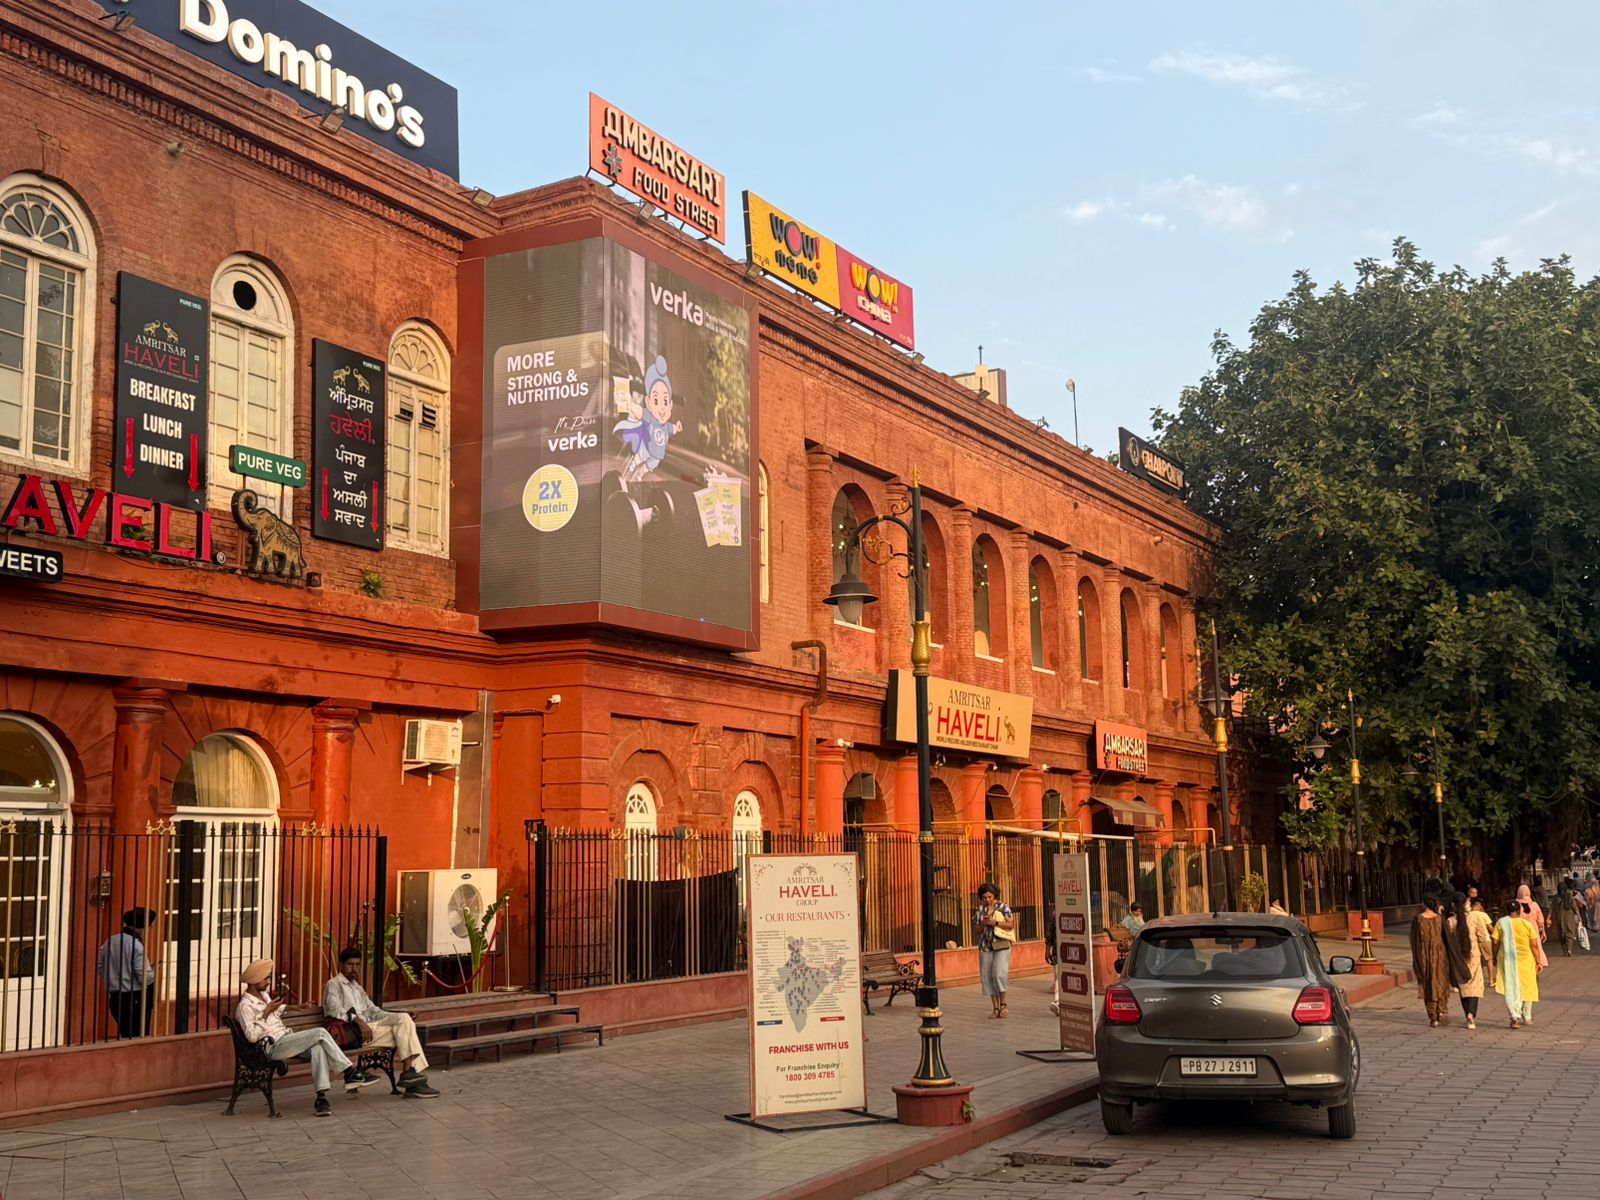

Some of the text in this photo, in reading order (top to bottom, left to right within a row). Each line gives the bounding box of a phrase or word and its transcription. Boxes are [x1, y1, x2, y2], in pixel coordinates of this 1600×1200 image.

[179, 0, 426, 148] Domino's
[602, 106, 722, 208] AMBARSARI
[633, 166, 721, 235] FOOD STREET
[769, 212, 821, 270] WOW!
[851, 262, 899, 313] WOW!
[650, 281, 705, 327] verka
[135, 334, 187, 358] AMRITSAR
[507, 350, 555, 373] MORE
[507, 368, 578, 391] STRONG &
[130, 378, 196, 412] BREAKFAST
[507, 382, 589, 406] NUTRITIOUS
[143, 413, 182, 439] LUNCH
[329, 412, 373, 445] ਹਵੇਲੀ
[548, 431, 598, 452] verka
[140, 443, 184, 470] DINNER
[238, 452, 302, 480] PURE VEG
[335, 444, 367, 469] ਪੰਜਾਬ
[344, 470, 357, 485] ਦਾ
[333, 488, 368, 509] ਅਸਲੀ
[539, 480, 562, 500] 2X
[334, 508, 366, 528] ਸਵਾਦ
[532, 502, 568, 515] Protein
[948, 689, 991, 711] AMRITSAR
[1104, 733, 1146, 759] AMBARSARI
[787, 876, 825, 885] AMRITSAR
[796, 899, 819, 907] GROUP
[765, 911, 845, 922] OUR RESTAURANTS
[1066, 945, 1080, 961] LUNCH
[1067, 975, 1082, 991] DINNER
[768, 1041, 849, 1054] FRANCHISE WITH US
[785, 1070, 835, 1082] 1800 309 4785
[788, 1064, 816, 1072] Franchise
[817, 1062, 840, 1070] Enquiry
[1189, 1060, 1202, 1072] PB
[1204, 1060, 1216, 1072] 27
[1220, 1061, 1225, 1072] J
[1229, 1060, 1254, 1072] 2911
